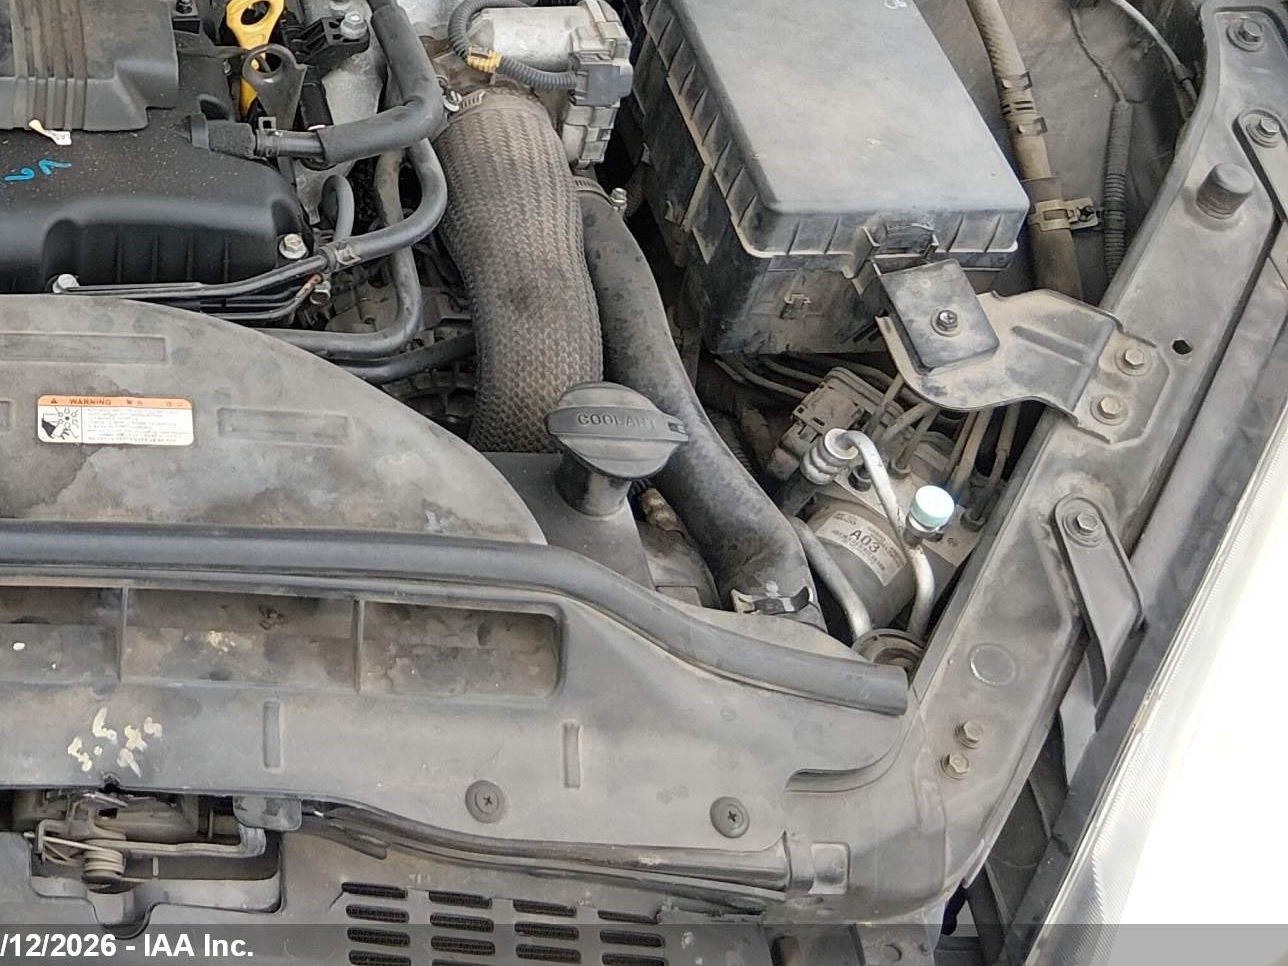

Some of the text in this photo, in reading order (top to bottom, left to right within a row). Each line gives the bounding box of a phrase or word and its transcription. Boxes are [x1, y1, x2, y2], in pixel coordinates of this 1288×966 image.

[69, 398, 112, 406] WARNING
[576, 411, 657, 431] COOLANT
[848, 527, 882, 556] A03
